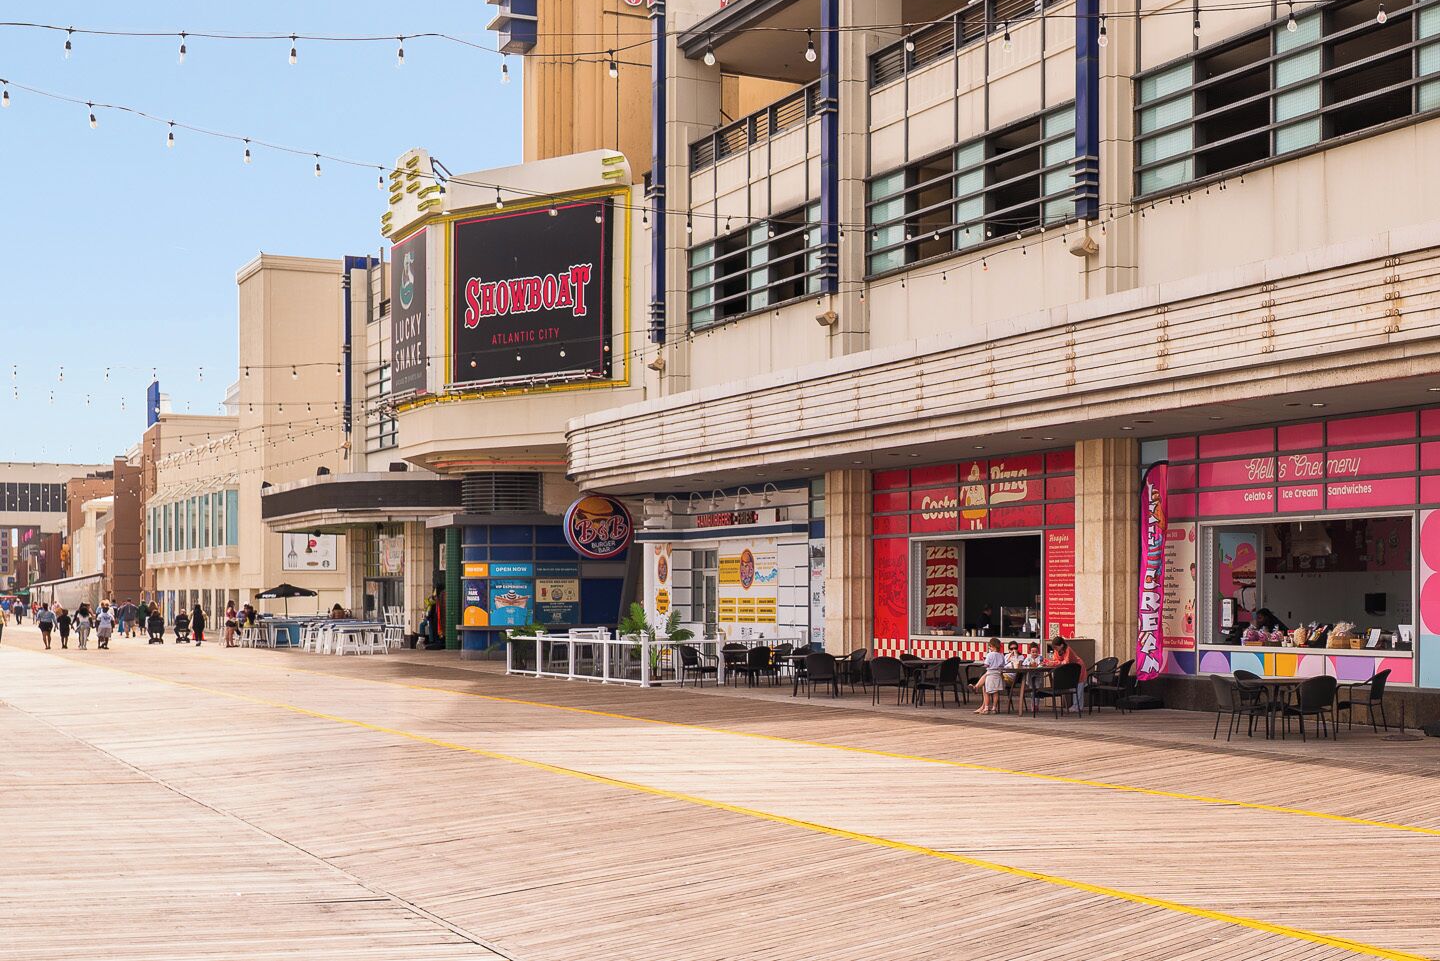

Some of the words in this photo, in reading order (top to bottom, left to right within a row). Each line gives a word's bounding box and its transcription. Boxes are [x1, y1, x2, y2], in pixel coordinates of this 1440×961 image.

[464, 262, 593, 329] SHOWBOAT
[396, 312, 422, 344] LUCKY
[491, 330, 535, 345] ATLANTIC
[538, 328, 560, 341] CITY
[396, 342, 422, 373] SNAKE
[921, 495, 958, 520] Costa
[990, 462, 1028, 493] Pizza
[1244, 492, 1266, 502] Gelato
[1267, 491, 1273, 500] &
[1282, 489, 1293, 498] Ice
[1294, 488, 1319, 498] Cream
[1328, 484, 1372, 496] Sandwiches
[575, 515, 628, 544] B&B
[591, 540, 616, 549] BURGER
